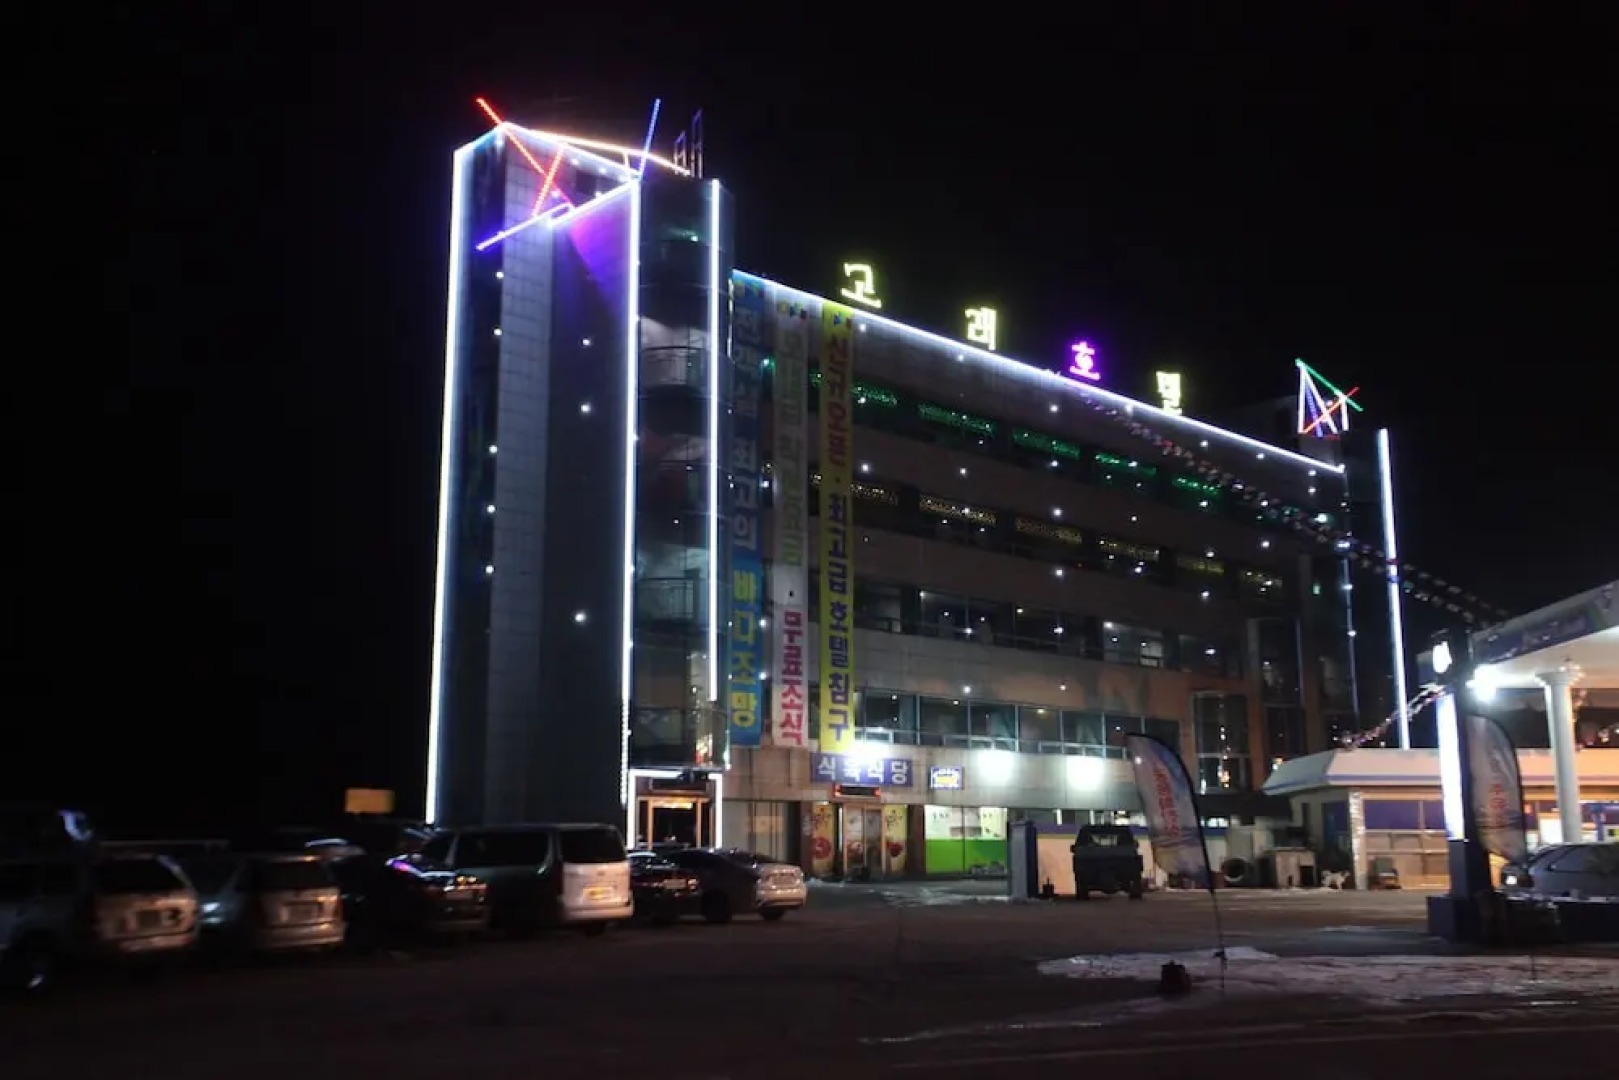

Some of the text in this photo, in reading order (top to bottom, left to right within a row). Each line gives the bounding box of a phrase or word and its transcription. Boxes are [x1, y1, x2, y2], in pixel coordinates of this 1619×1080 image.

[731, 437, 758, 551] 최고의
[826, 338, 849, 741] 신규오픈 최고급 호텔침구
[730, 569, 758, 728] 바다조망
[779, 609, 805, 745] 무료조식
